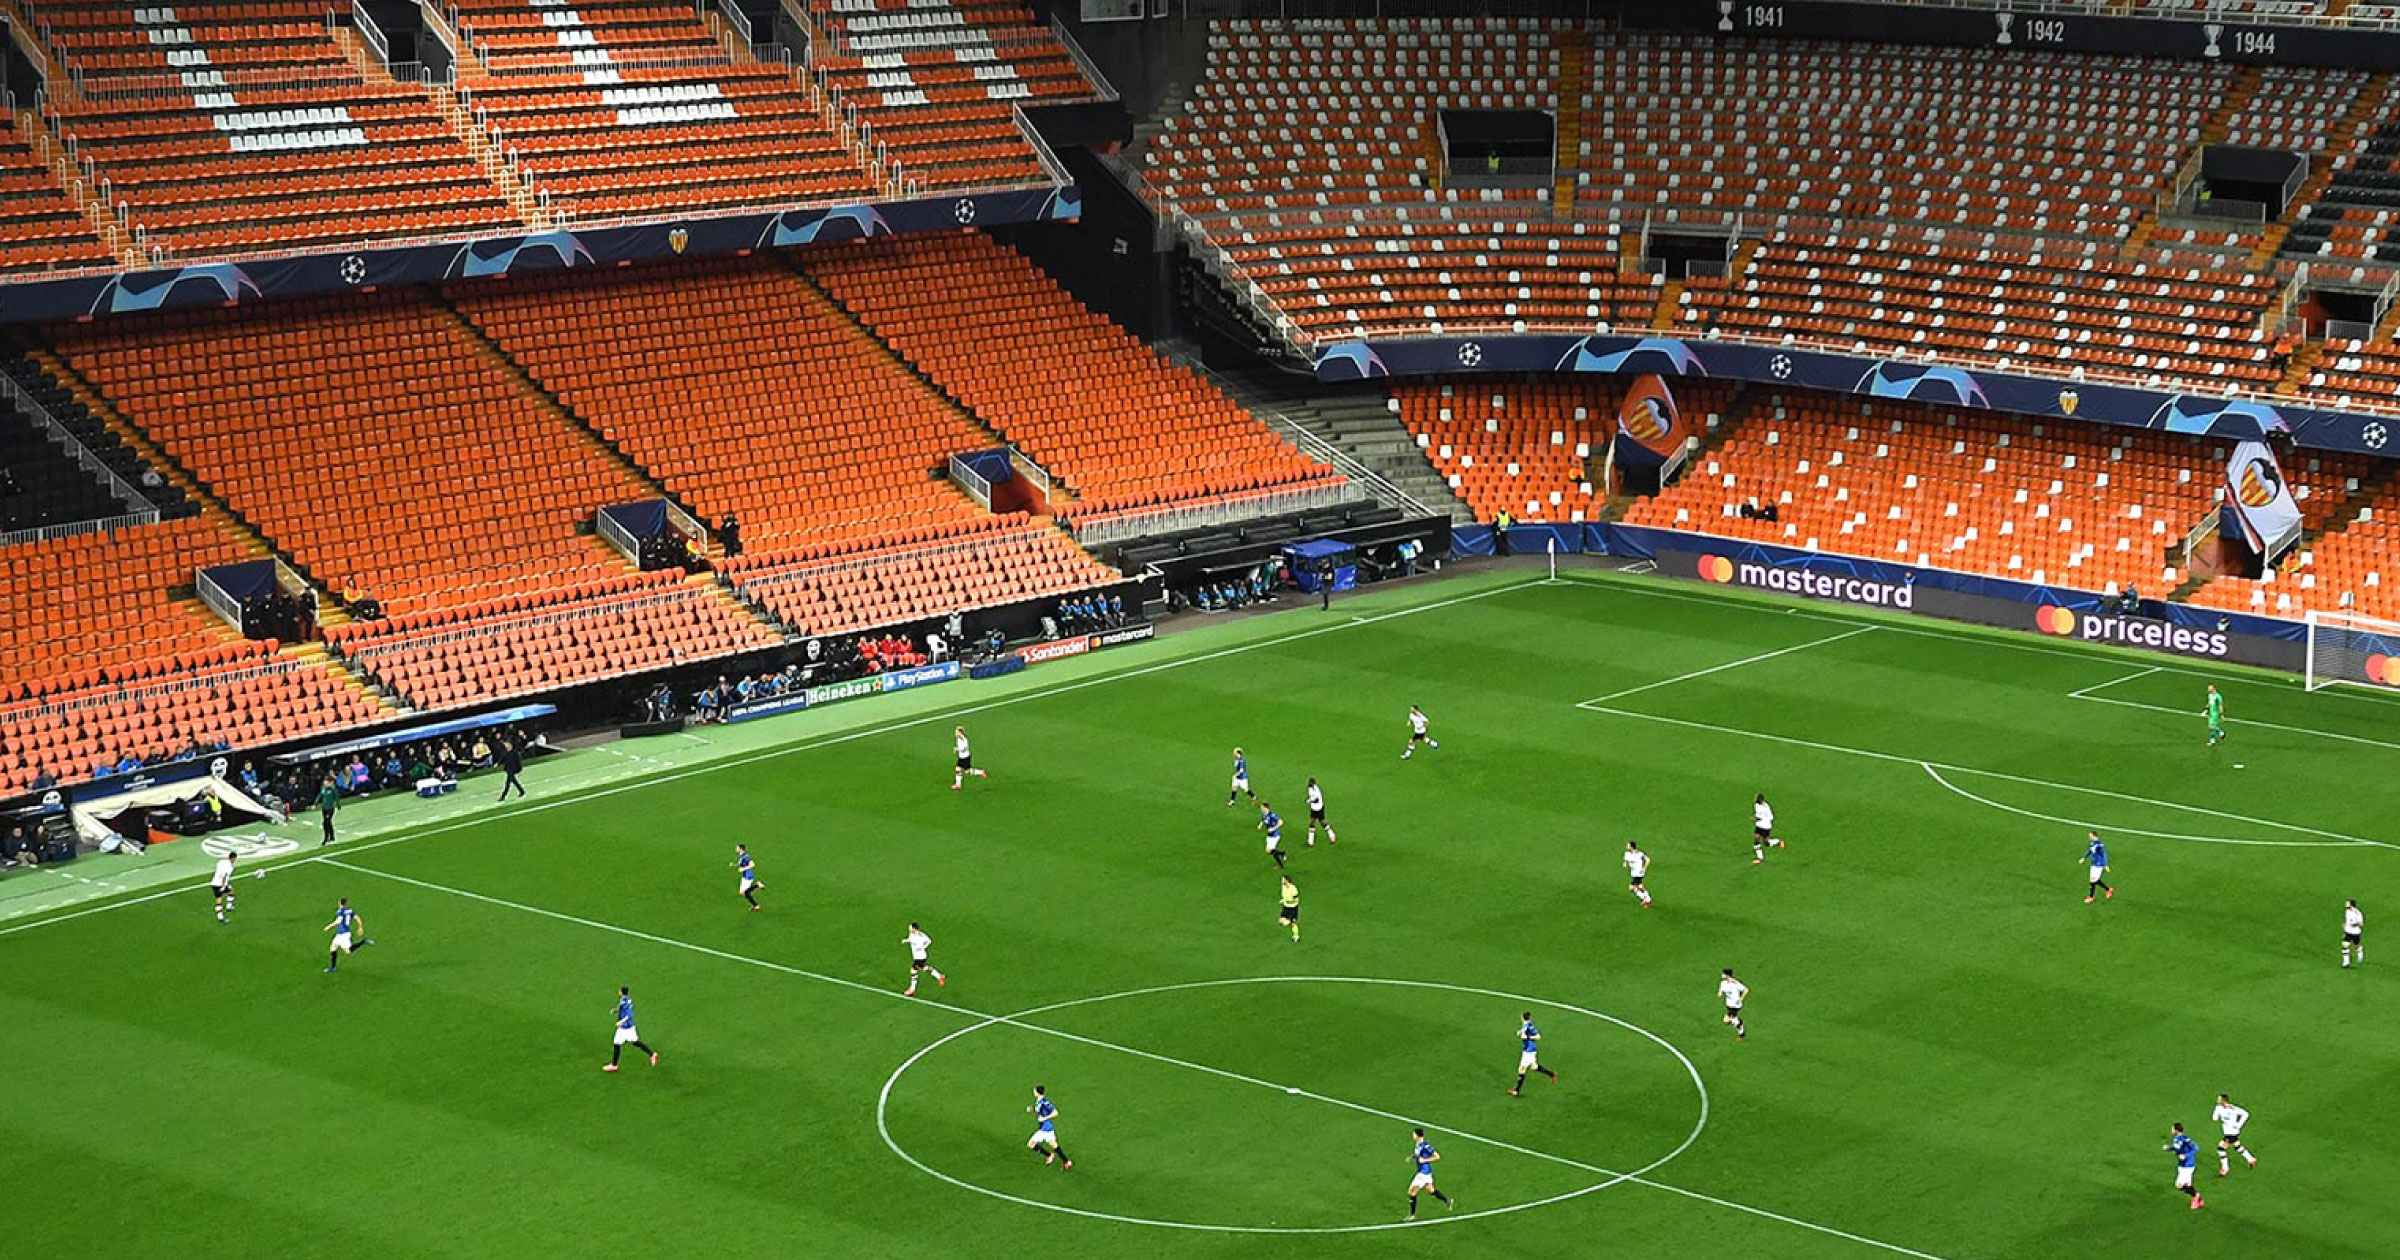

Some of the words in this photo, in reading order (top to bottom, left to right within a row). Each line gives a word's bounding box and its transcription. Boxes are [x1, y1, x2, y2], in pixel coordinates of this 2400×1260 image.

[1745, 5, 1784, 27] 1941
[2026, 20, 2064, 42] 1942
[2234, 32, 2276, 54] 1944
[1740, 563, 1913, 608] mastercard
[1102, 625, 1153, 644] mastercard
[2083, 615, 2228, 656] priceless
[1031, 641, 1085, 662] Santander
[899, 667, 945, 686] PlayStation
[809, 681, 871, 702] Heineken
